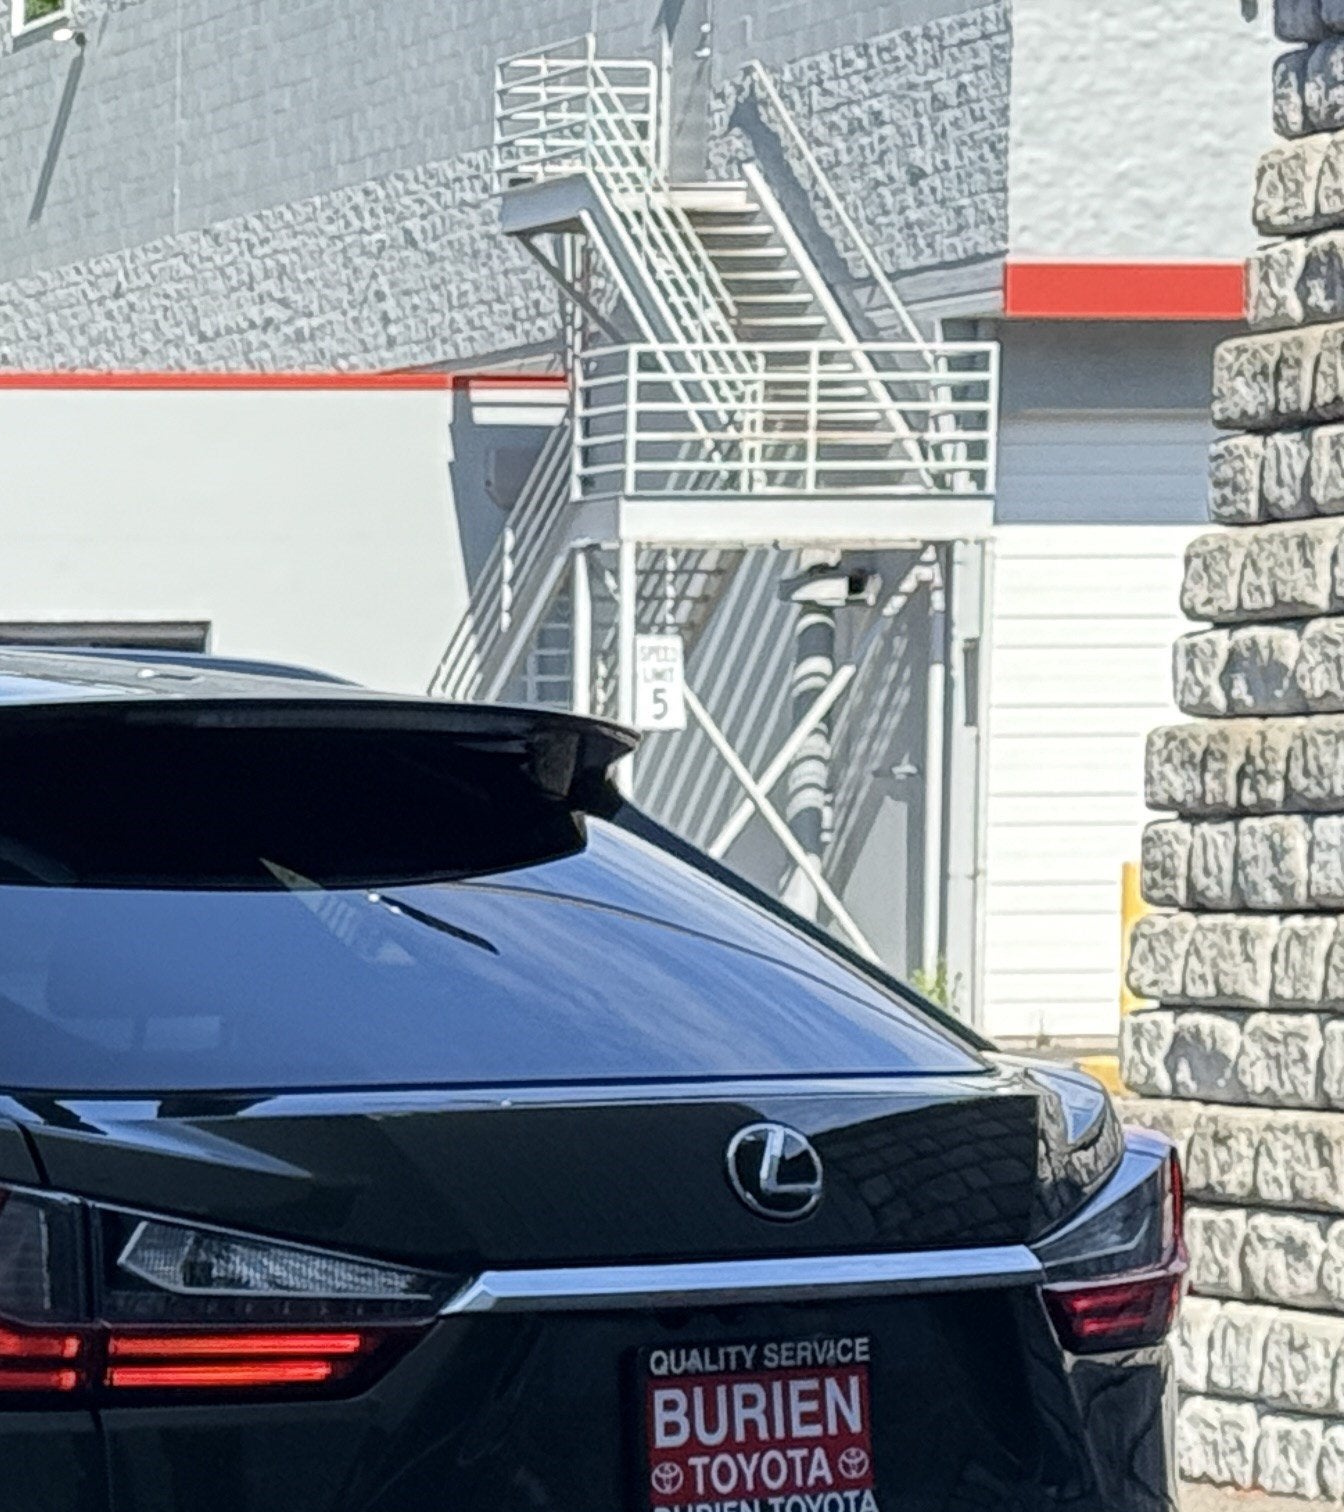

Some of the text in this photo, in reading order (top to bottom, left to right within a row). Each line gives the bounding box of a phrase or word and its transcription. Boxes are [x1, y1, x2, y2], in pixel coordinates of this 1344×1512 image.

[652, 688, 668, 720] 5
[649, 1336, 871, 1376] QUALITY SERVICE
[653, 1375, 863, 1449] BURIEN
[687, 1446, 834, 1495] TOYOTA
